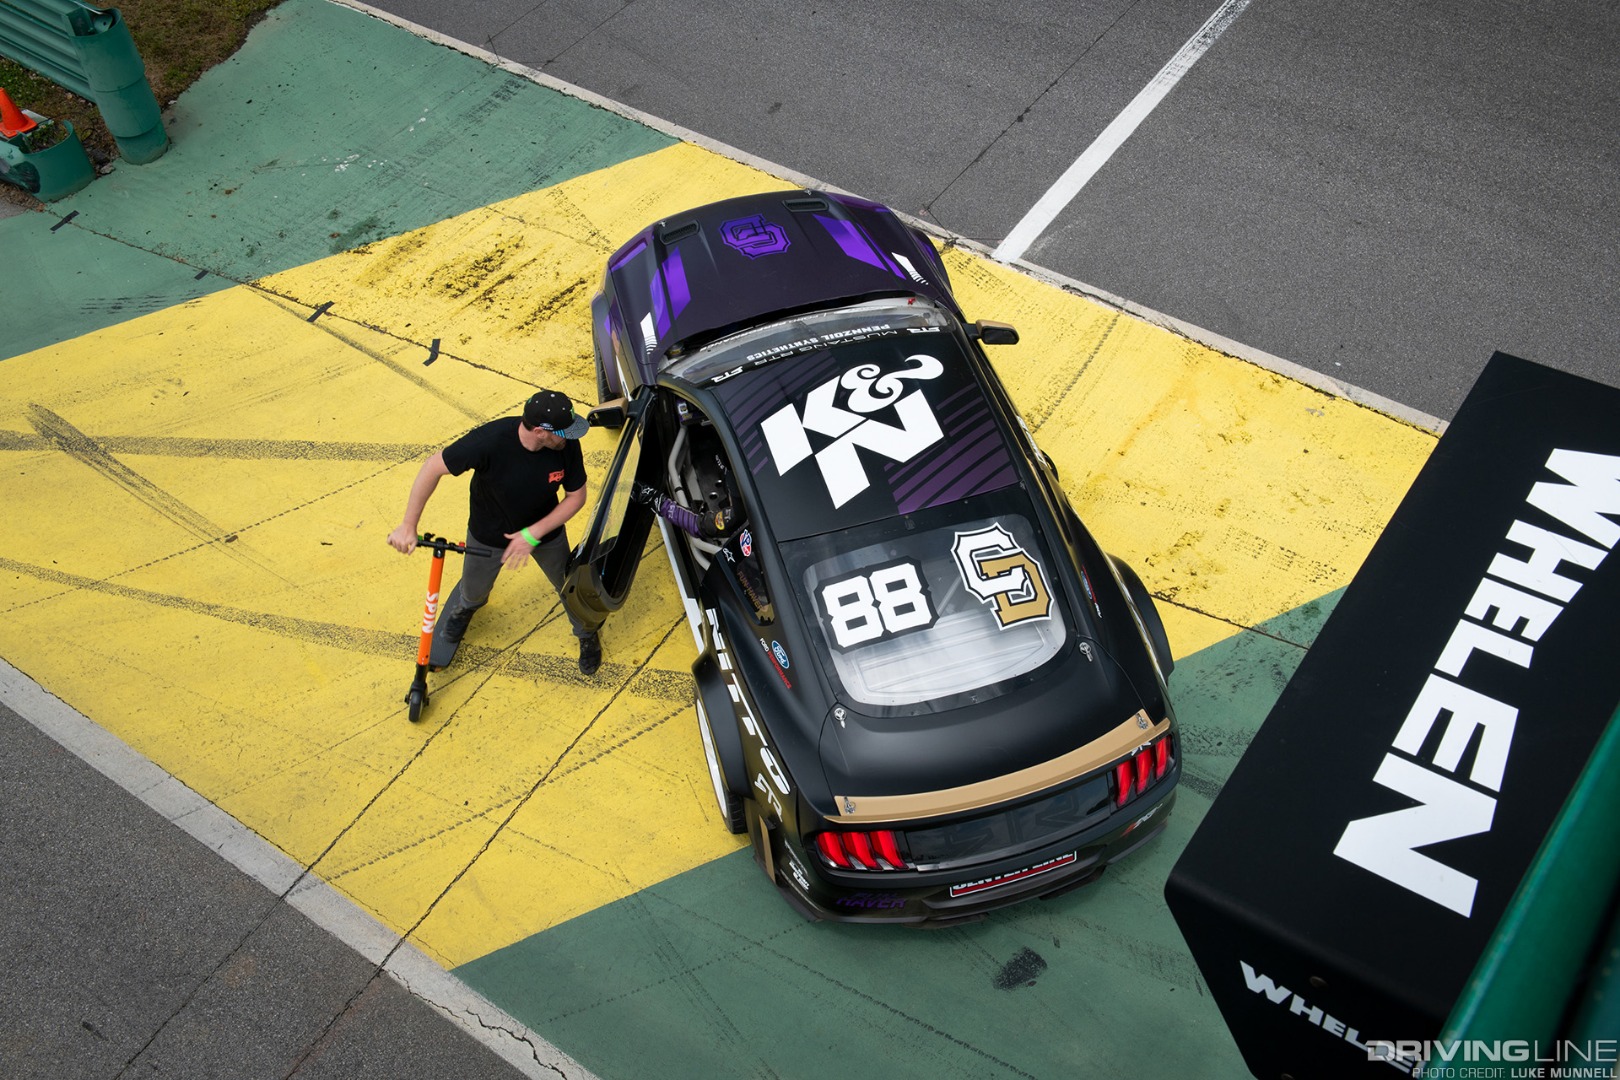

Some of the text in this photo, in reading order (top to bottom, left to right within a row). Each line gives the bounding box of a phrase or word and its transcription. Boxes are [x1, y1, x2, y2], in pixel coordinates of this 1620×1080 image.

[746, 324, 890, 361] PENNZOIL SYNTHETICS
[754, 330, 898, 366] MUSTANG RTR
[760, 354, 944, 510] K&N
[422, 591, 439, 634] SPIN
[821, 562, 933, 649] 88
[760, 637, 792, 689] FORD PERFORMANCE
[1333, 448, 1620, 919] WHELEN
[705, 607, 791, 795] NITTO
